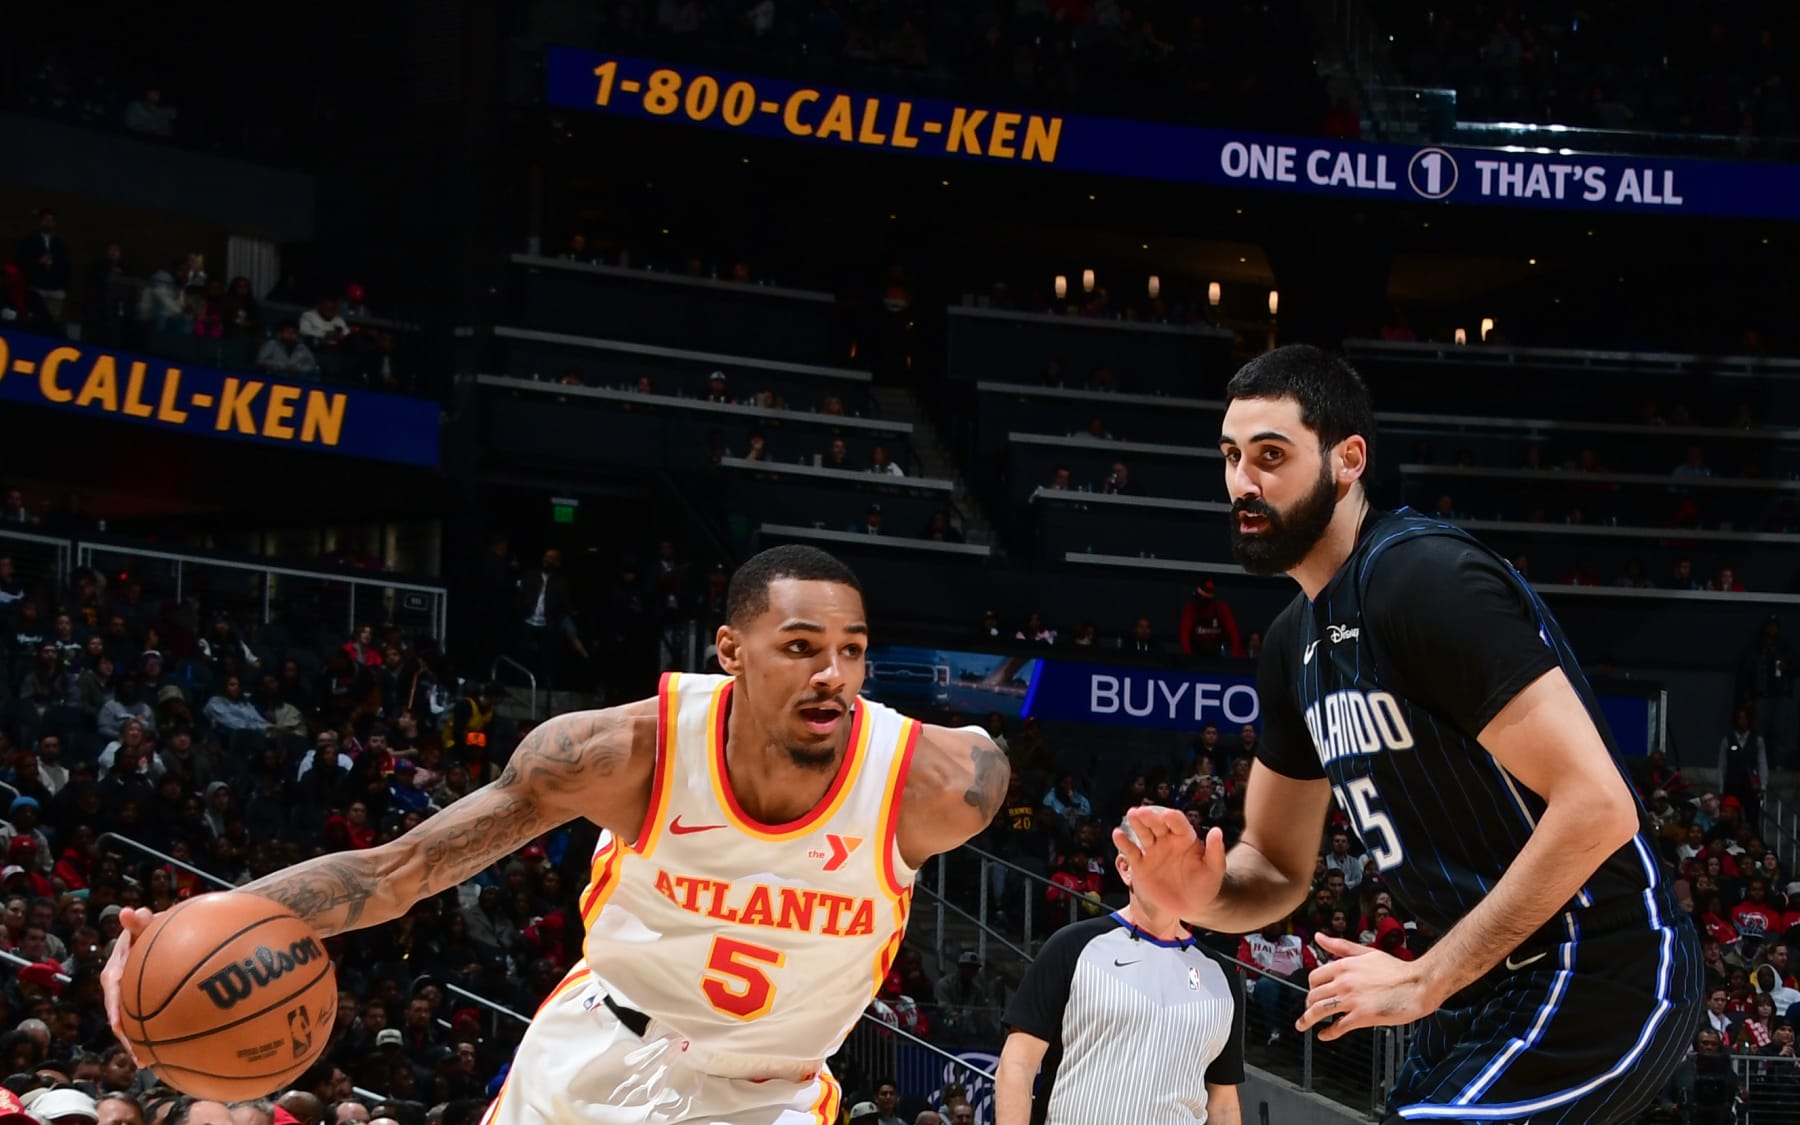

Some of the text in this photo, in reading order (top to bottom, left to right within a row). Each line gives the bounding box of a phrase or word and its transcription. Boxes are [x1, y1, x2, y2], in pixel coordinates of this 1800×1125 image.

[593, 60, 1063, 163] 1-800-CALL-KEN
[1220, 141, 1297, 182] ONE
[1305, 149, 1397, 190] CALL
[1474, 160, 1606, 202] THAT'S
[1614, 168, 1683, 205] ALL
[0, 335, 348, 446] -CALL-KEN
[1089, 673, 1262, 725] BUYFO
[808, 849, 825, 859] the
[654, 868, 876, 938] ATLANTA
[197, 936, 322, 1009] Wilson
[701, 935, 786, 1022] 5
